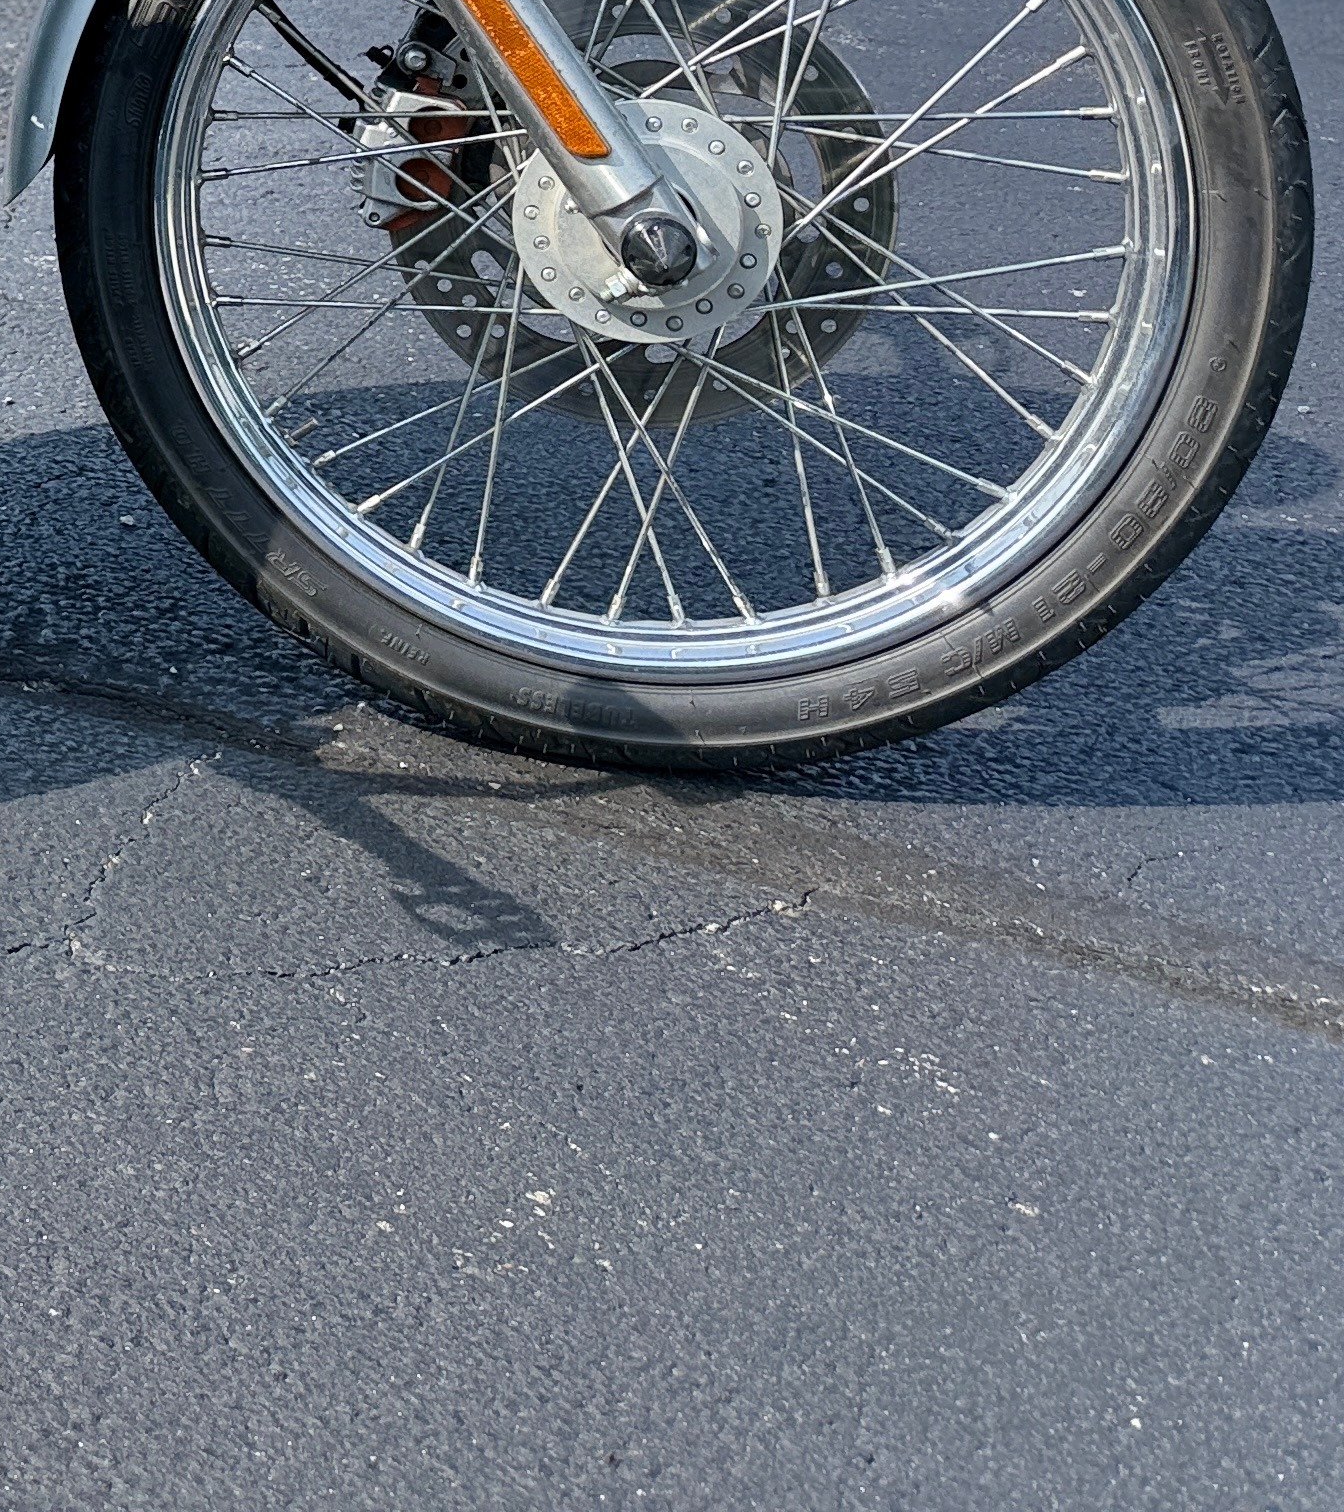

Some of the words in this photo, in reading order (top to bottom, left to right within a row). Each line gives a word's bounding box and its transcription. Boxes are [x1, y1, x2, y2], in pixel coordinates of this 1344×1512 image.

[1184, 40, 1212, 86] FRONT
[1211, 32, 1246, 104] ROTATION
[942, 618, 1021, 676] M/C
[510, 686, 638, 730] TUBELESS
